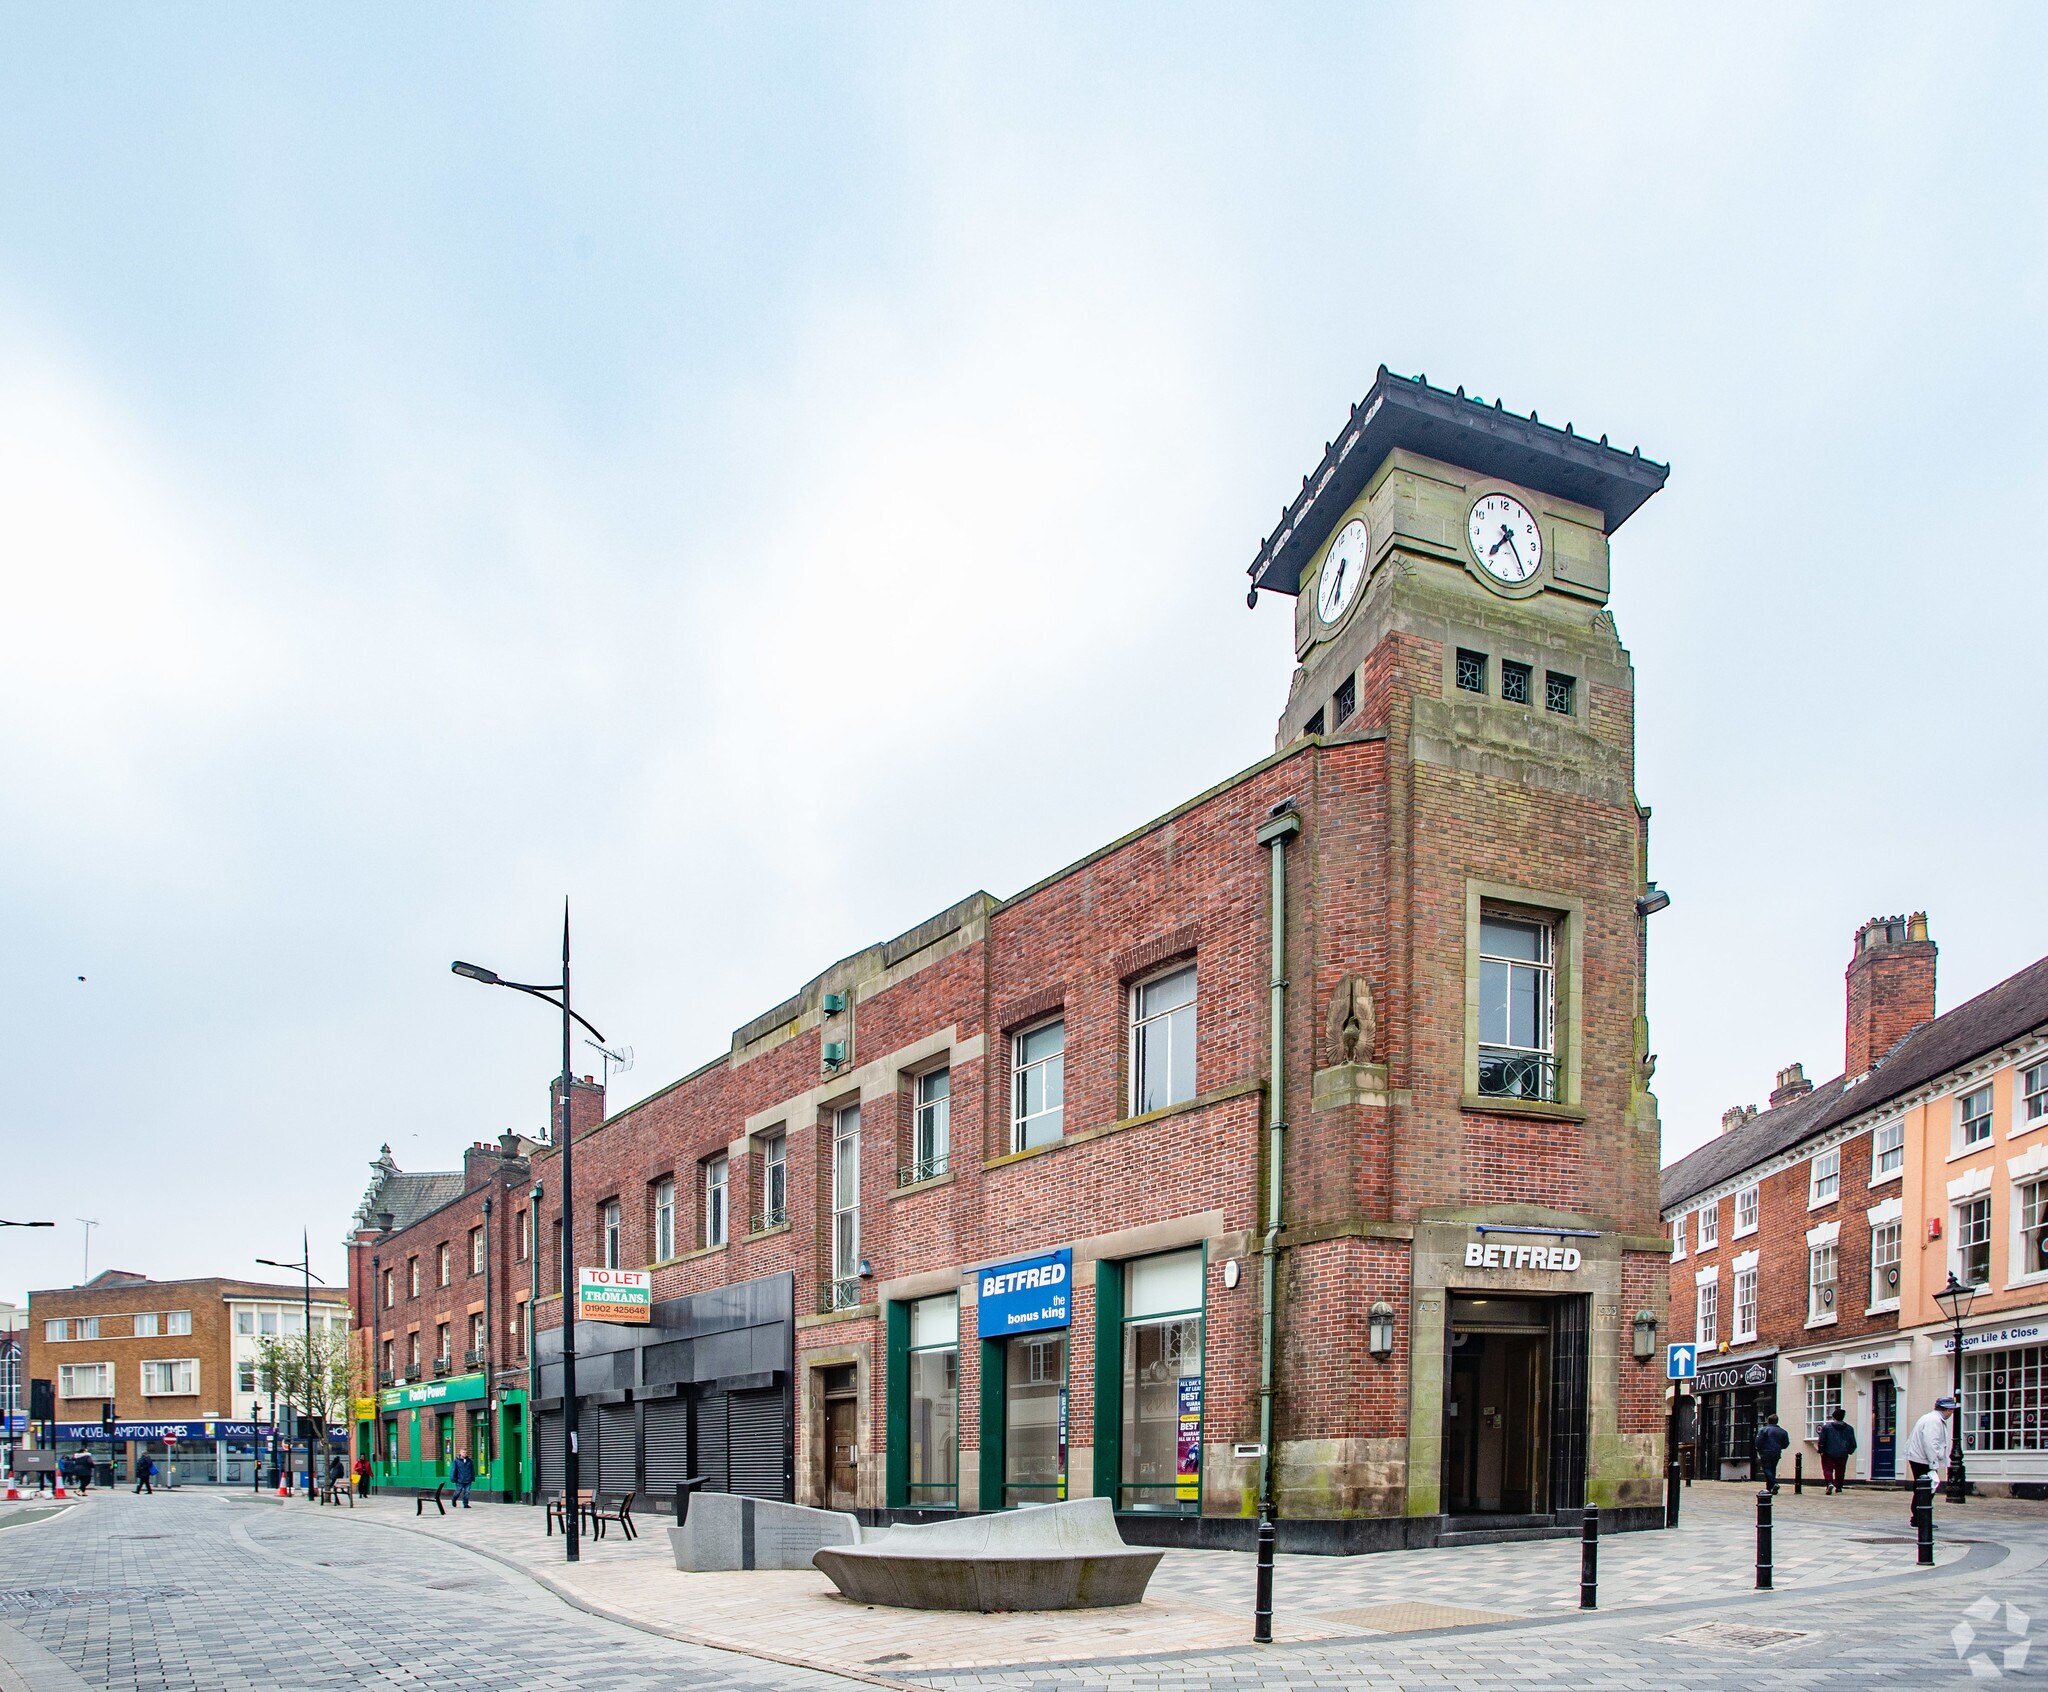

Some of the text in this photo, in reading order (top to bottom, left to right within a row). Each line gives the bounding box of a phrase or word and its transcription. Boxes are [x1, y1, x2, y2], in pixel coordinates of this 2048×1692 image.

[1487, 500, 1494, 510] 11
[1500, 500, 1510, 510] 12
[1474, 509, 1484, 520] 10
[1526, 524, 1533, 534] 2
[1530, 542, 1536, 552] 3
[1464, 1242, 1582, 1272] BETFRED
[589, 1270, 642, 1285] TO LET
[982, 1263, 1066, 1298] BETFRED
[585, 1291, 644, 1304] TROMANS
[1053, 1294, 1066, 1306] the
[584, 1304, 646, 1314] 01902 425646
[1008, 1306, 1066, 1324] bonus king
[1944, 1327, 2038, 1348] Jakson Lile & Close
[1811, 1360, 1826, 1368] Agents
[1696, 1370, 1738, 1390] TATTOO
[409, 1388, 427, 1402] Paddy
[428, 1386, 447, 1398] Power
[1181, 1392, 1199, 1400] BEST
[154, 1425, 188, 1436] HOMES
[1180, 1422, 1198, 1430] BEST
